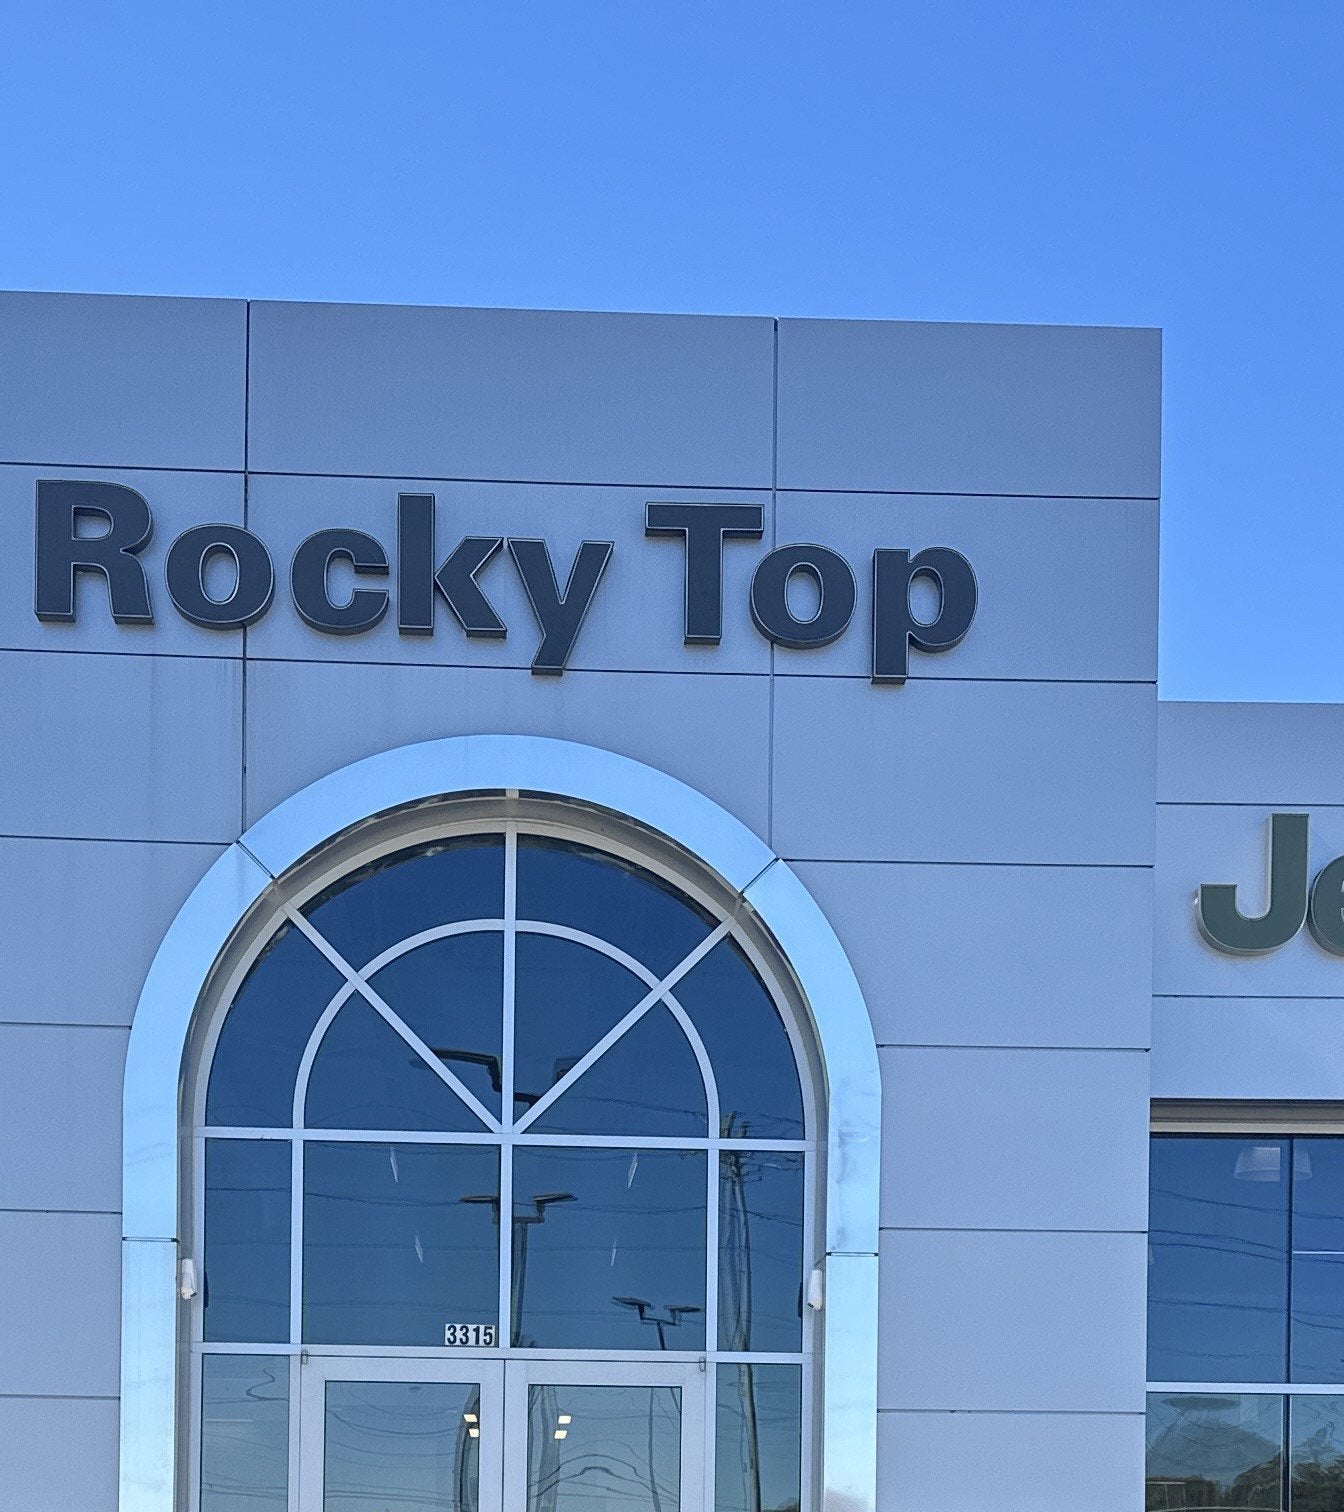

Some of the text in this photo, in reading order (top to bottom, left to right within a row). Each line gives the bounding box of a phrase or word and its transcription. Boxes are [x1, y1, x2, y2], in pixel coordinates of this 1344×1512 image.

[34, 479, 979, 684] Rocky Top
[447, 1324, 493, 1346] 3315
